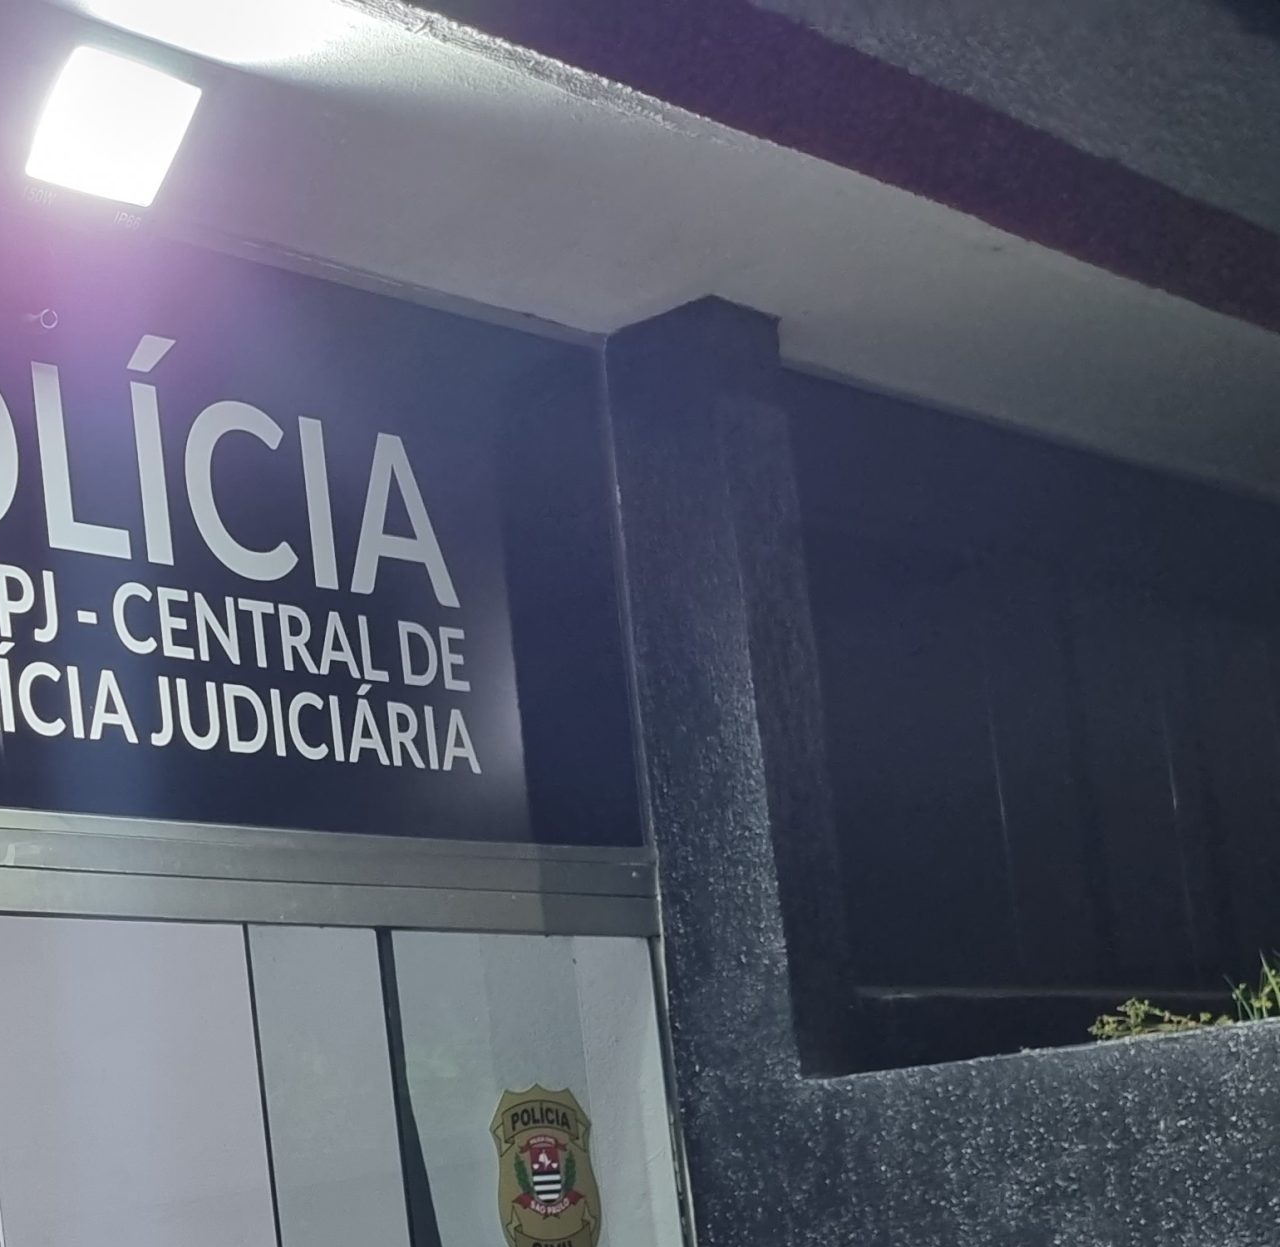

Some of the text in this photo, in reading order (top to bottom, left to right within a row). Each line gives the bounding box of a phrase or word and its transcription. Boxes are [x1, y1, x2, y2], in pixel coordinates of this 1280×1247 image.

[77, 609, 98, 625] -
[112, 582, 389, 683] CENTRAL
[398, 620, 471, 692] DE
[151, 677, 482, 775] JUDICIÁRIA
